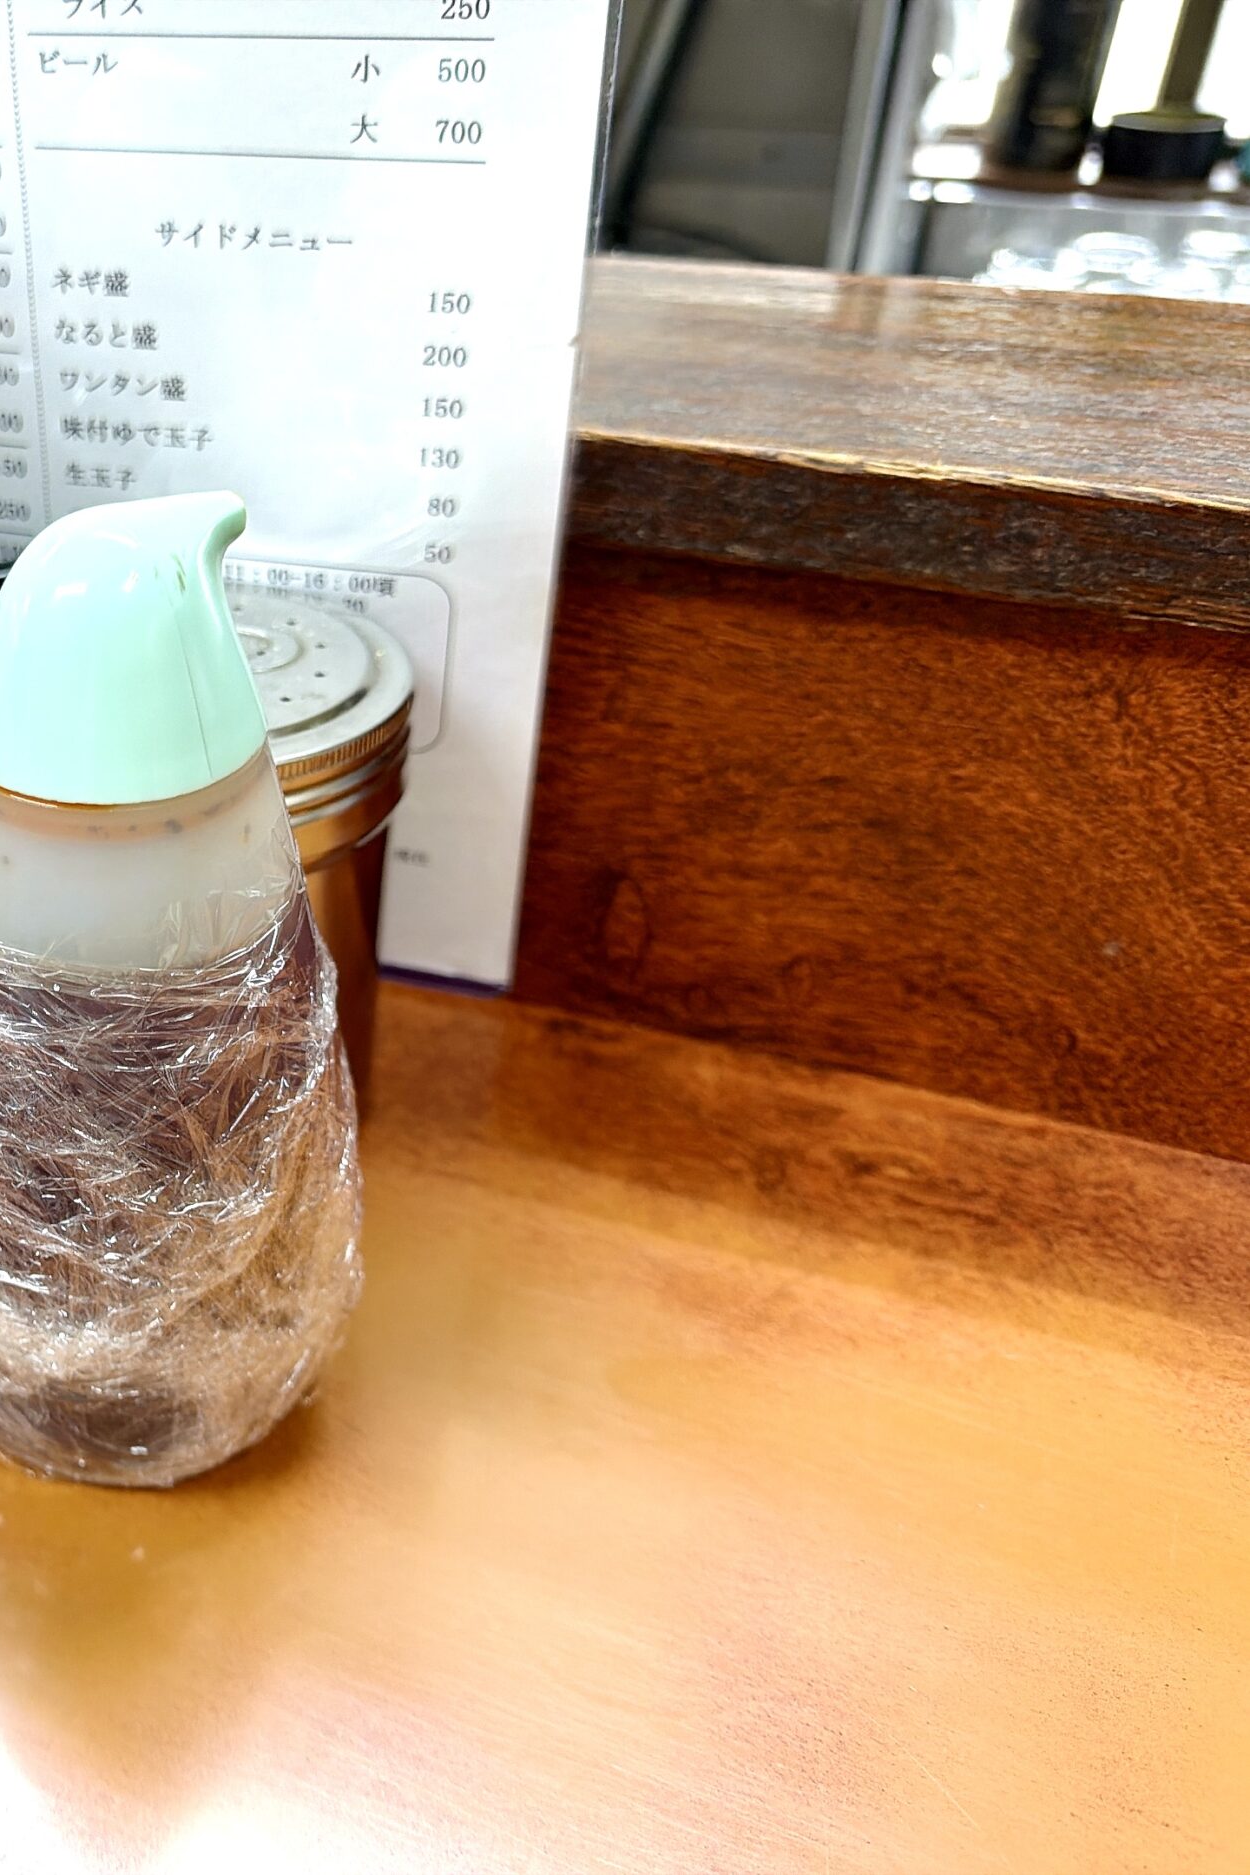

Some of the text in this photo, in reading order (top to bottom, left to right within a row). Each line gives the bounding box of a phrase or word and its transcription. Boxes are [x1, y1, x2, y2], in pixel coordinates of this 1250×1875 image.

[440, 0, 491, 20] 250
[39, 50, 486, 84] ビール 小 500
[350, 114, 482, 145] 大 700
[155, 220, 354, 251] サイドメニュー
[52, 267, 471, 315] ネギ盛 150
[55, 318, 467, 368] なると盛 200
[59, 370, 465, 419] ワンタン盛 150
[61, 415, 461, 469] 味付ゆで玉子 130
[65, 463, 456, 518] 生玉子 80
[424, 544, 453, 564] 50
